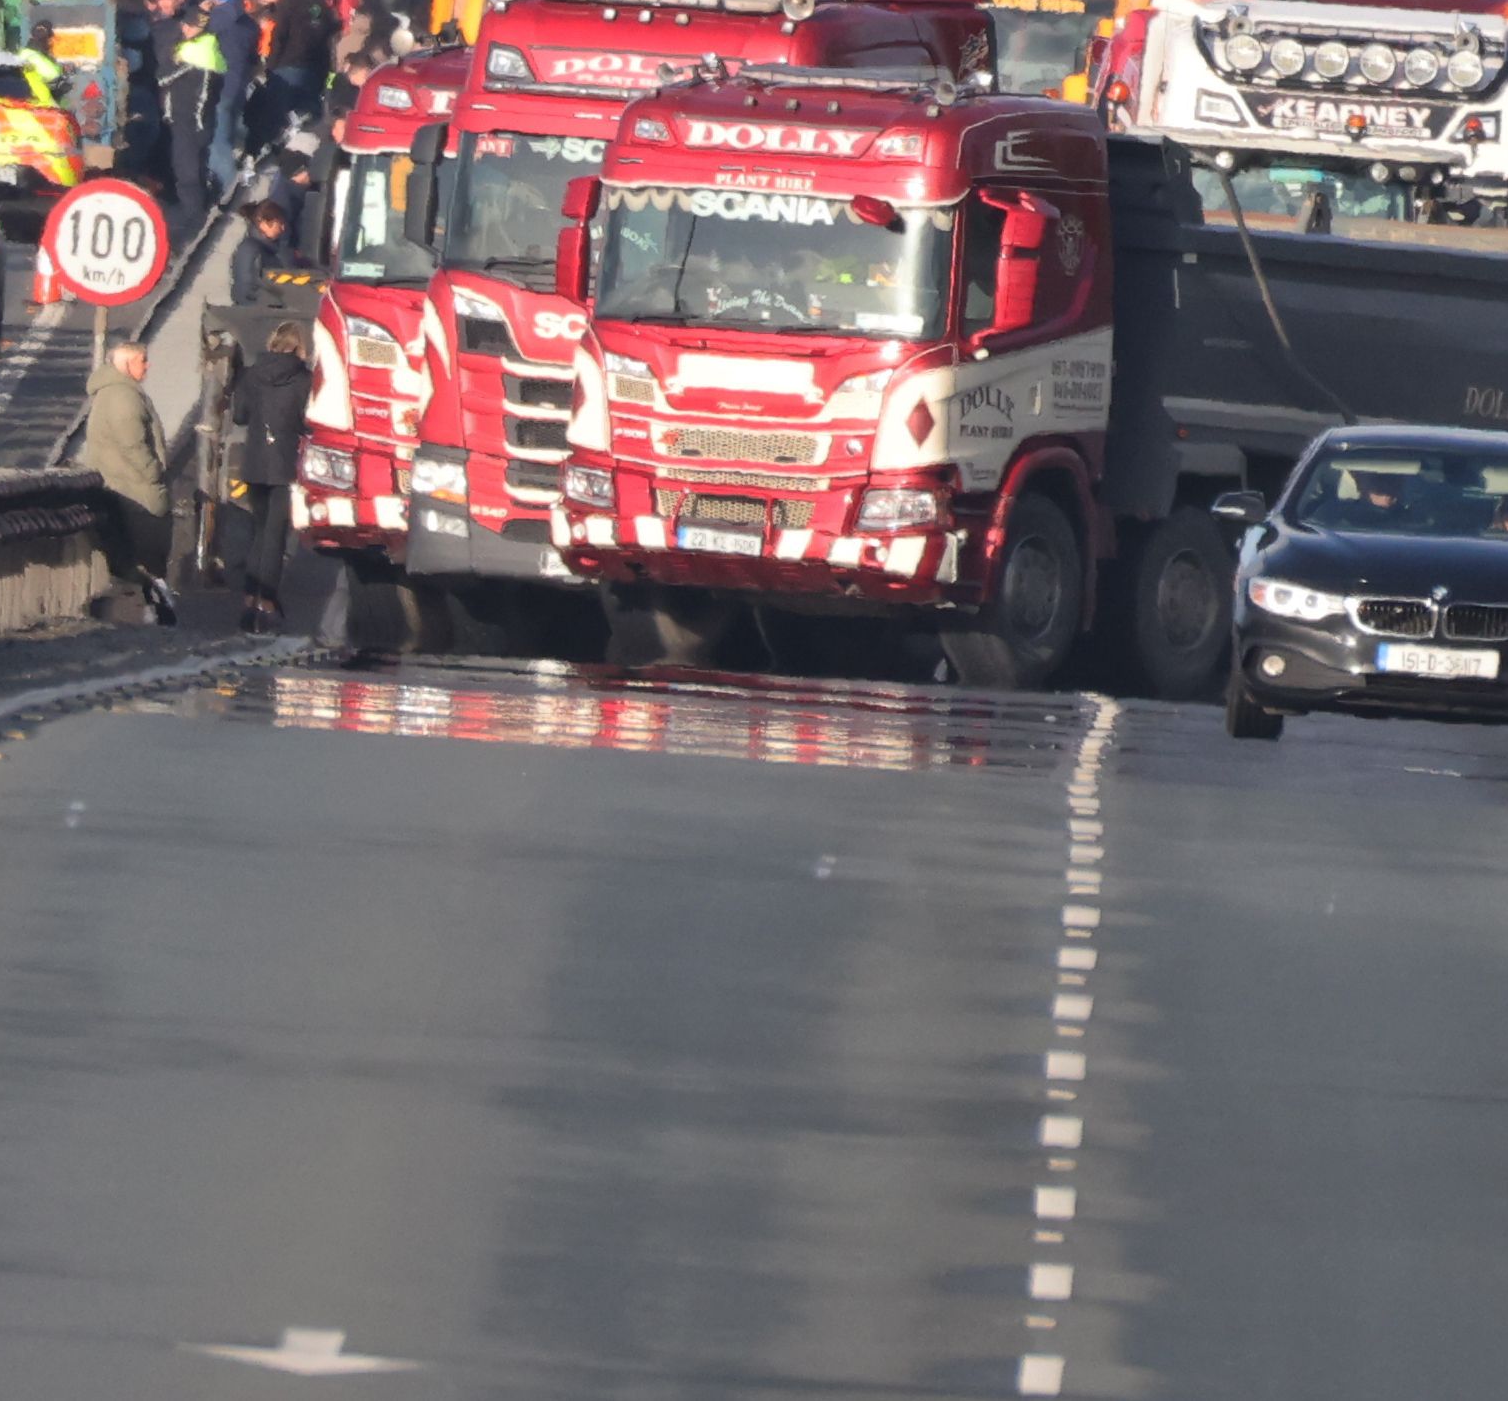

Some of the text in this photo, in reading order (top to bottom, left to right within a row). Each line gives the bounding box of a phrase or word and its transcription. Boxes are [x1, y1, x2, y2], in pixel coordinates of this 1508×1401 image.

[1275, 98, 1431, 127] KEARNEY
[686, 119, 866, 155] DOLLY
[715, 173, 814, 190] PLANT HIRE
[690, 190, 835, 226] SCANIA
[70, 210, 146, 262] 100
[82, 266, 126, 286] km/h
